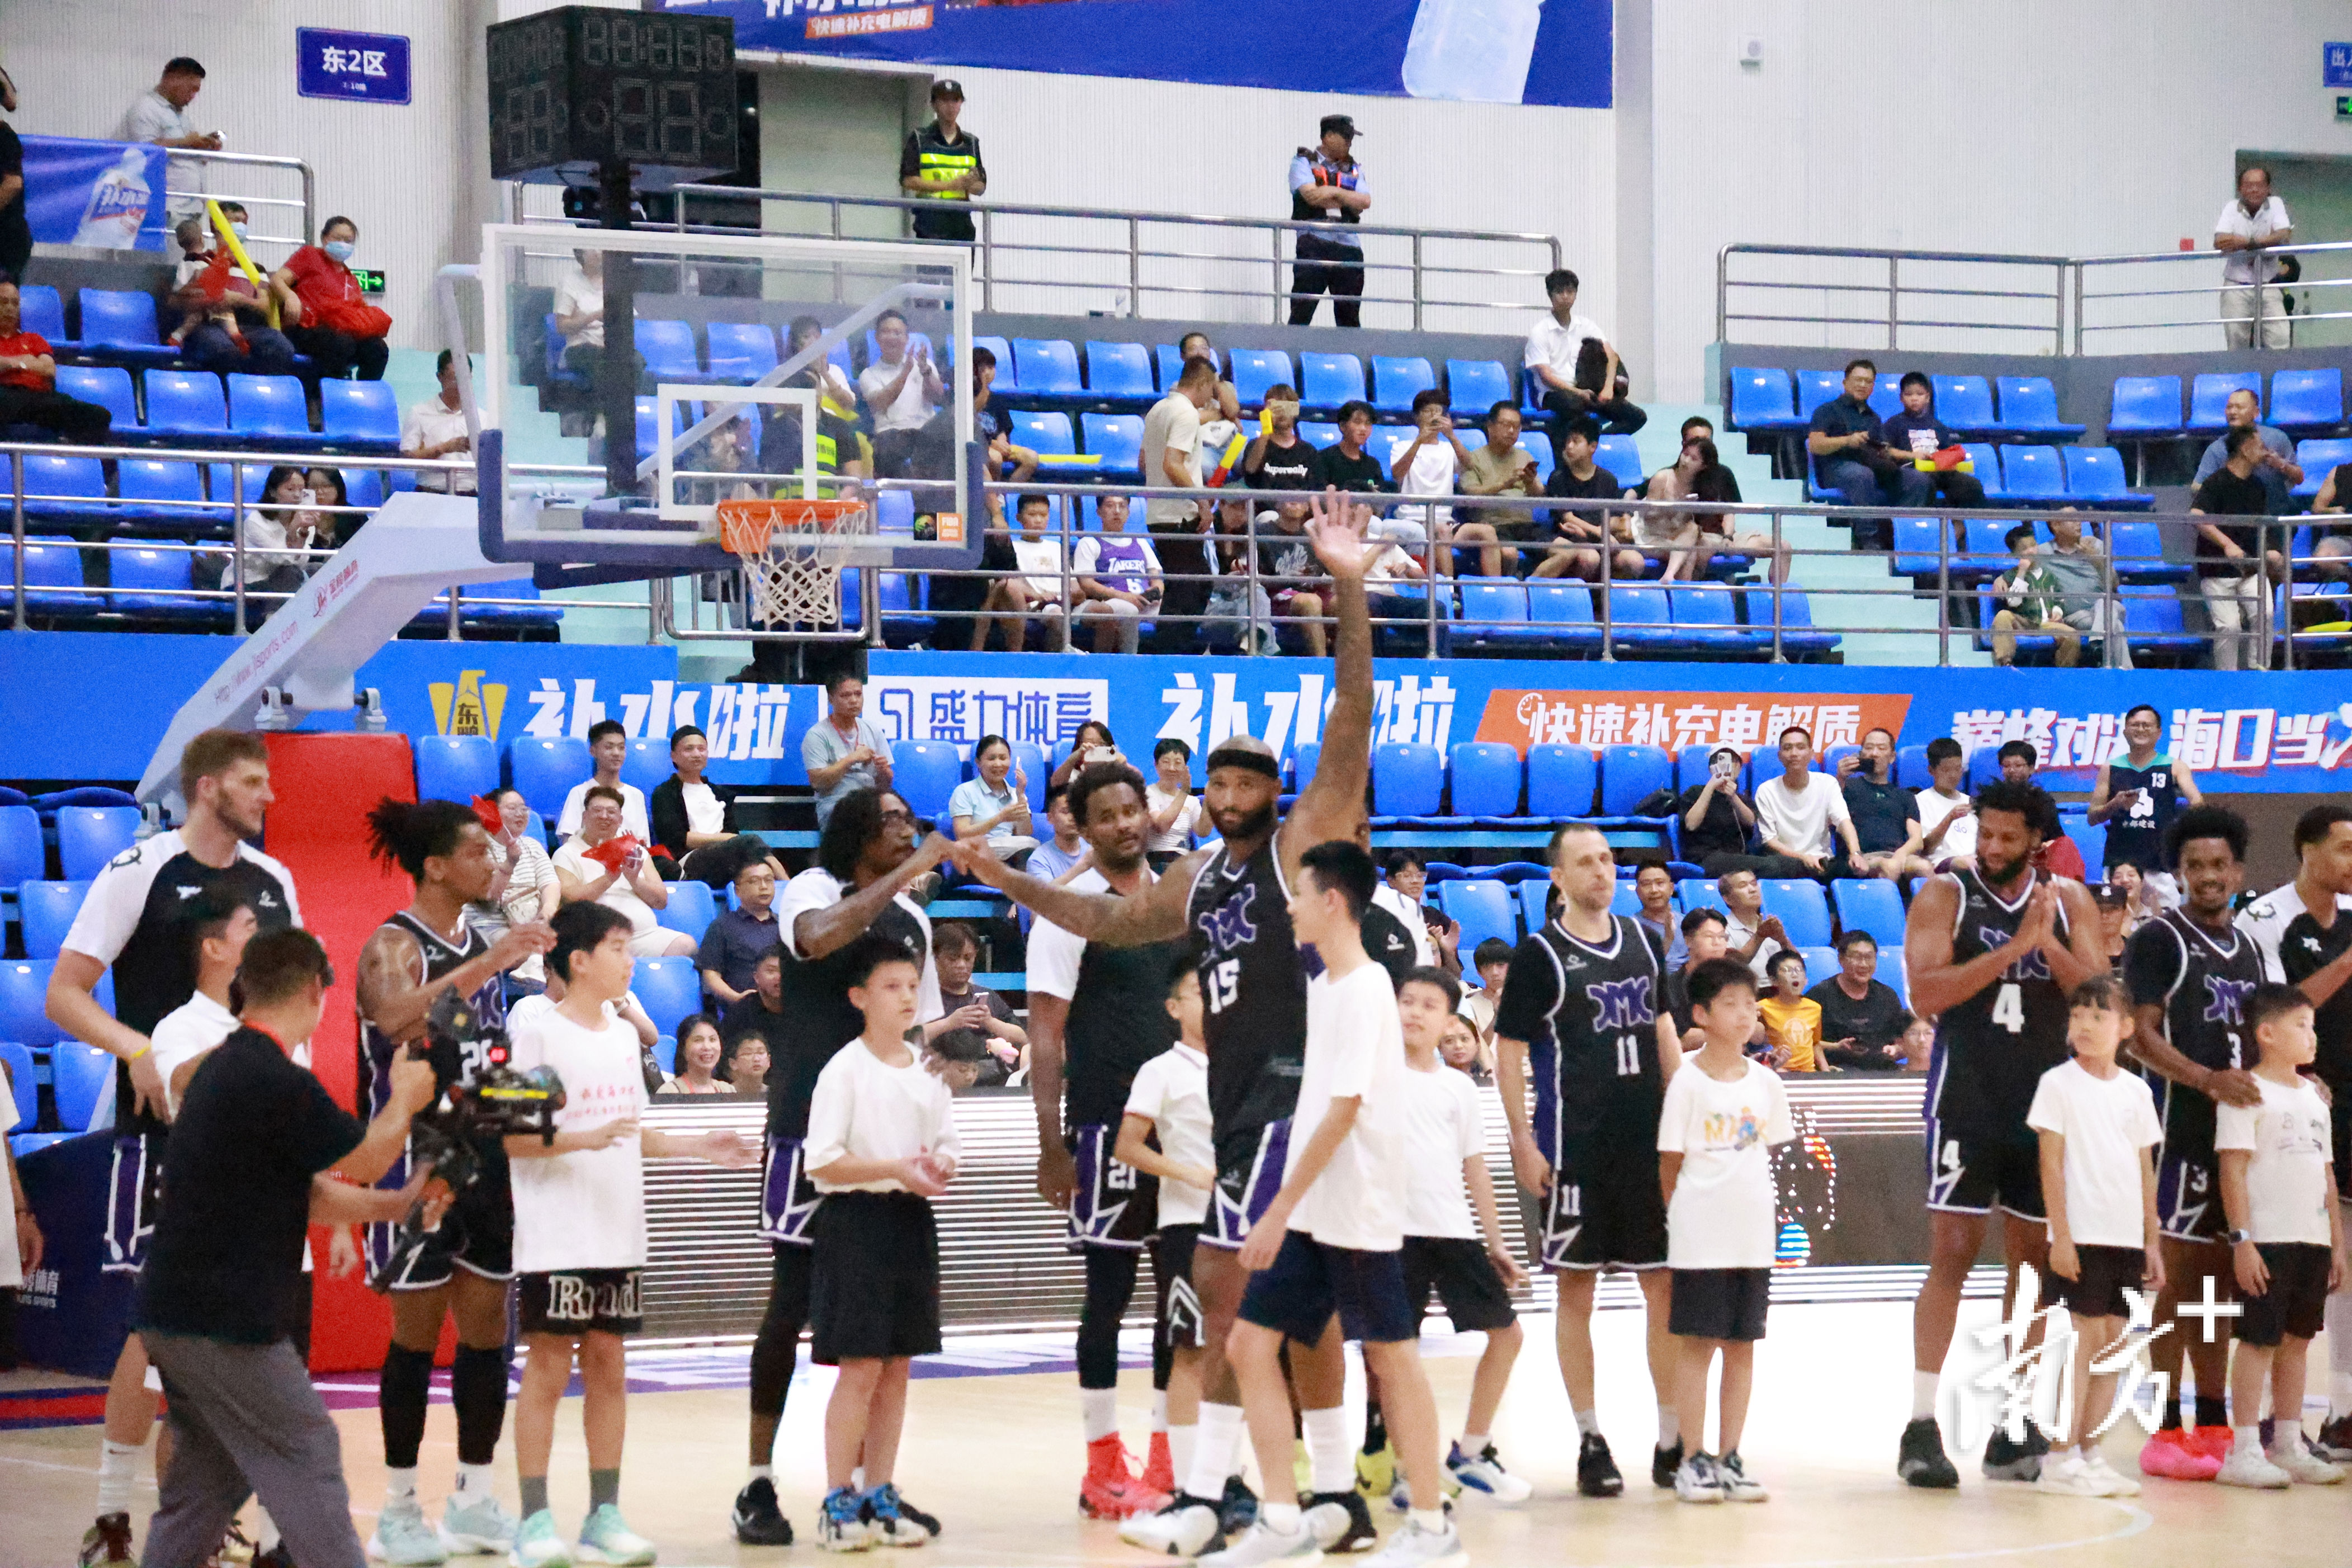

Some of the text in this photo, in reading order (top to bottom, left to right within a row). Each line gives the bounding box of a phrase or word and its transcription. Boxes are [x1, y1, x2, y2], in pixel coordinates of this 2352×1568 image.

[813, 7, 928, 36] 快速补充电解质
[322, 46, 387, 76] 东2区
[1108, 557, 1146, 574] LAKERS
[523, 678, 790, 761] 补水啦
[929, 689, 1092, 745] 盛力体育
[1155, 672, 1456, 769] 补水啦
[1528, 702, 1861, 753] 快速补充电解质
[2152, 772, 2166, 788] 13
[1208, 958, 1240, 1014] 15
[1992, 984, 2025, 1033] 4
[1616, 1035, 1640, 1075] 11
[1942, 1140, 1961, 1170] 4
[1108, 1156, 1136, 1190] 21
[2190, 1165, 2208, 1193] 3
[1561, 1184, 1580, 1216] 11
